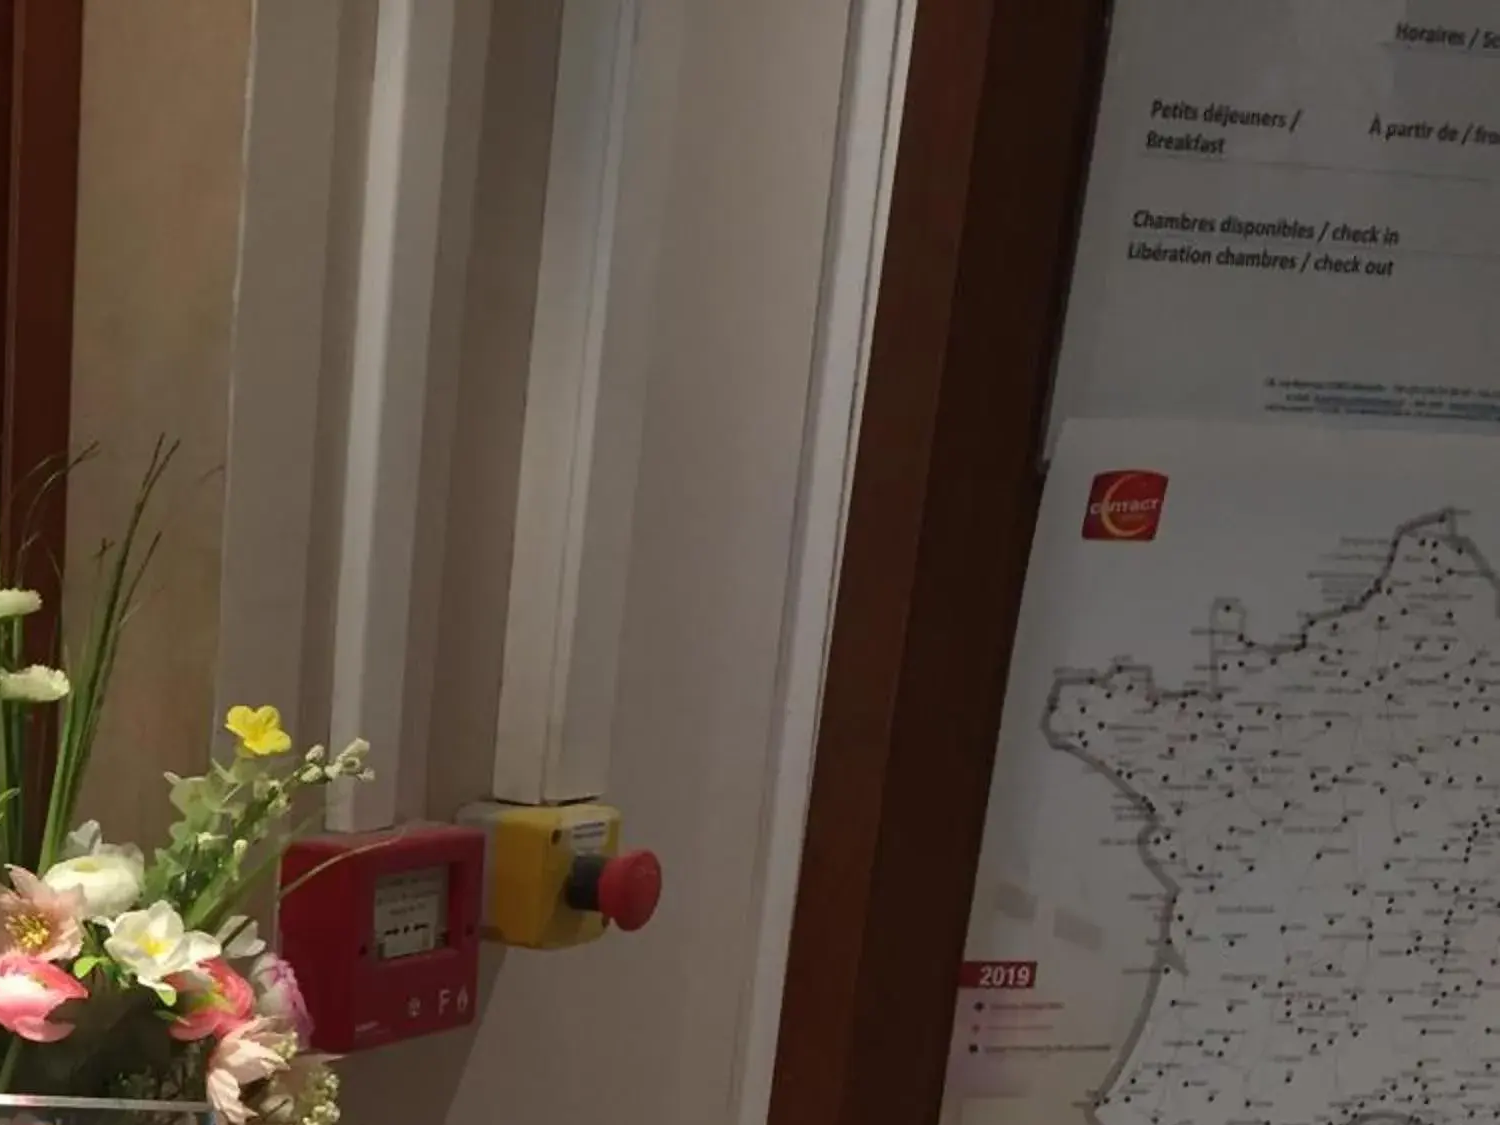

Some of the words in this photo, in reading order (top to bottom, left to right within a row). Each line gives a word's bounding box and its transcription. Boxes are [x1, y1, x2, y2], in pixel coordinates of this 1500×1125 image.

[1395, 22, 1466, 47] Horaires
[1151, 99, 1198, 122] Petits
[1203, 102, 1287, 129] déjeuners
[1146, 129, 1226, 155] Breakfast
[1385, 119, 1433, 142] partir
[1437, 122, 1458, 143] de
[1132, 208, 1216, 234] Chambres
[1220, 212, 1314, 243] disponibles
[1331, 222, 1378, 246] check
[1382, 227, 1400, 247] in
[1128, 240, 1212, 267] Libération
[1215, 244, 1297, 272] chambres
[1314, 252, 1360, 275] check
[1365, 258, 1394, 278] out
[979, 966, 1032, 988] 2019
